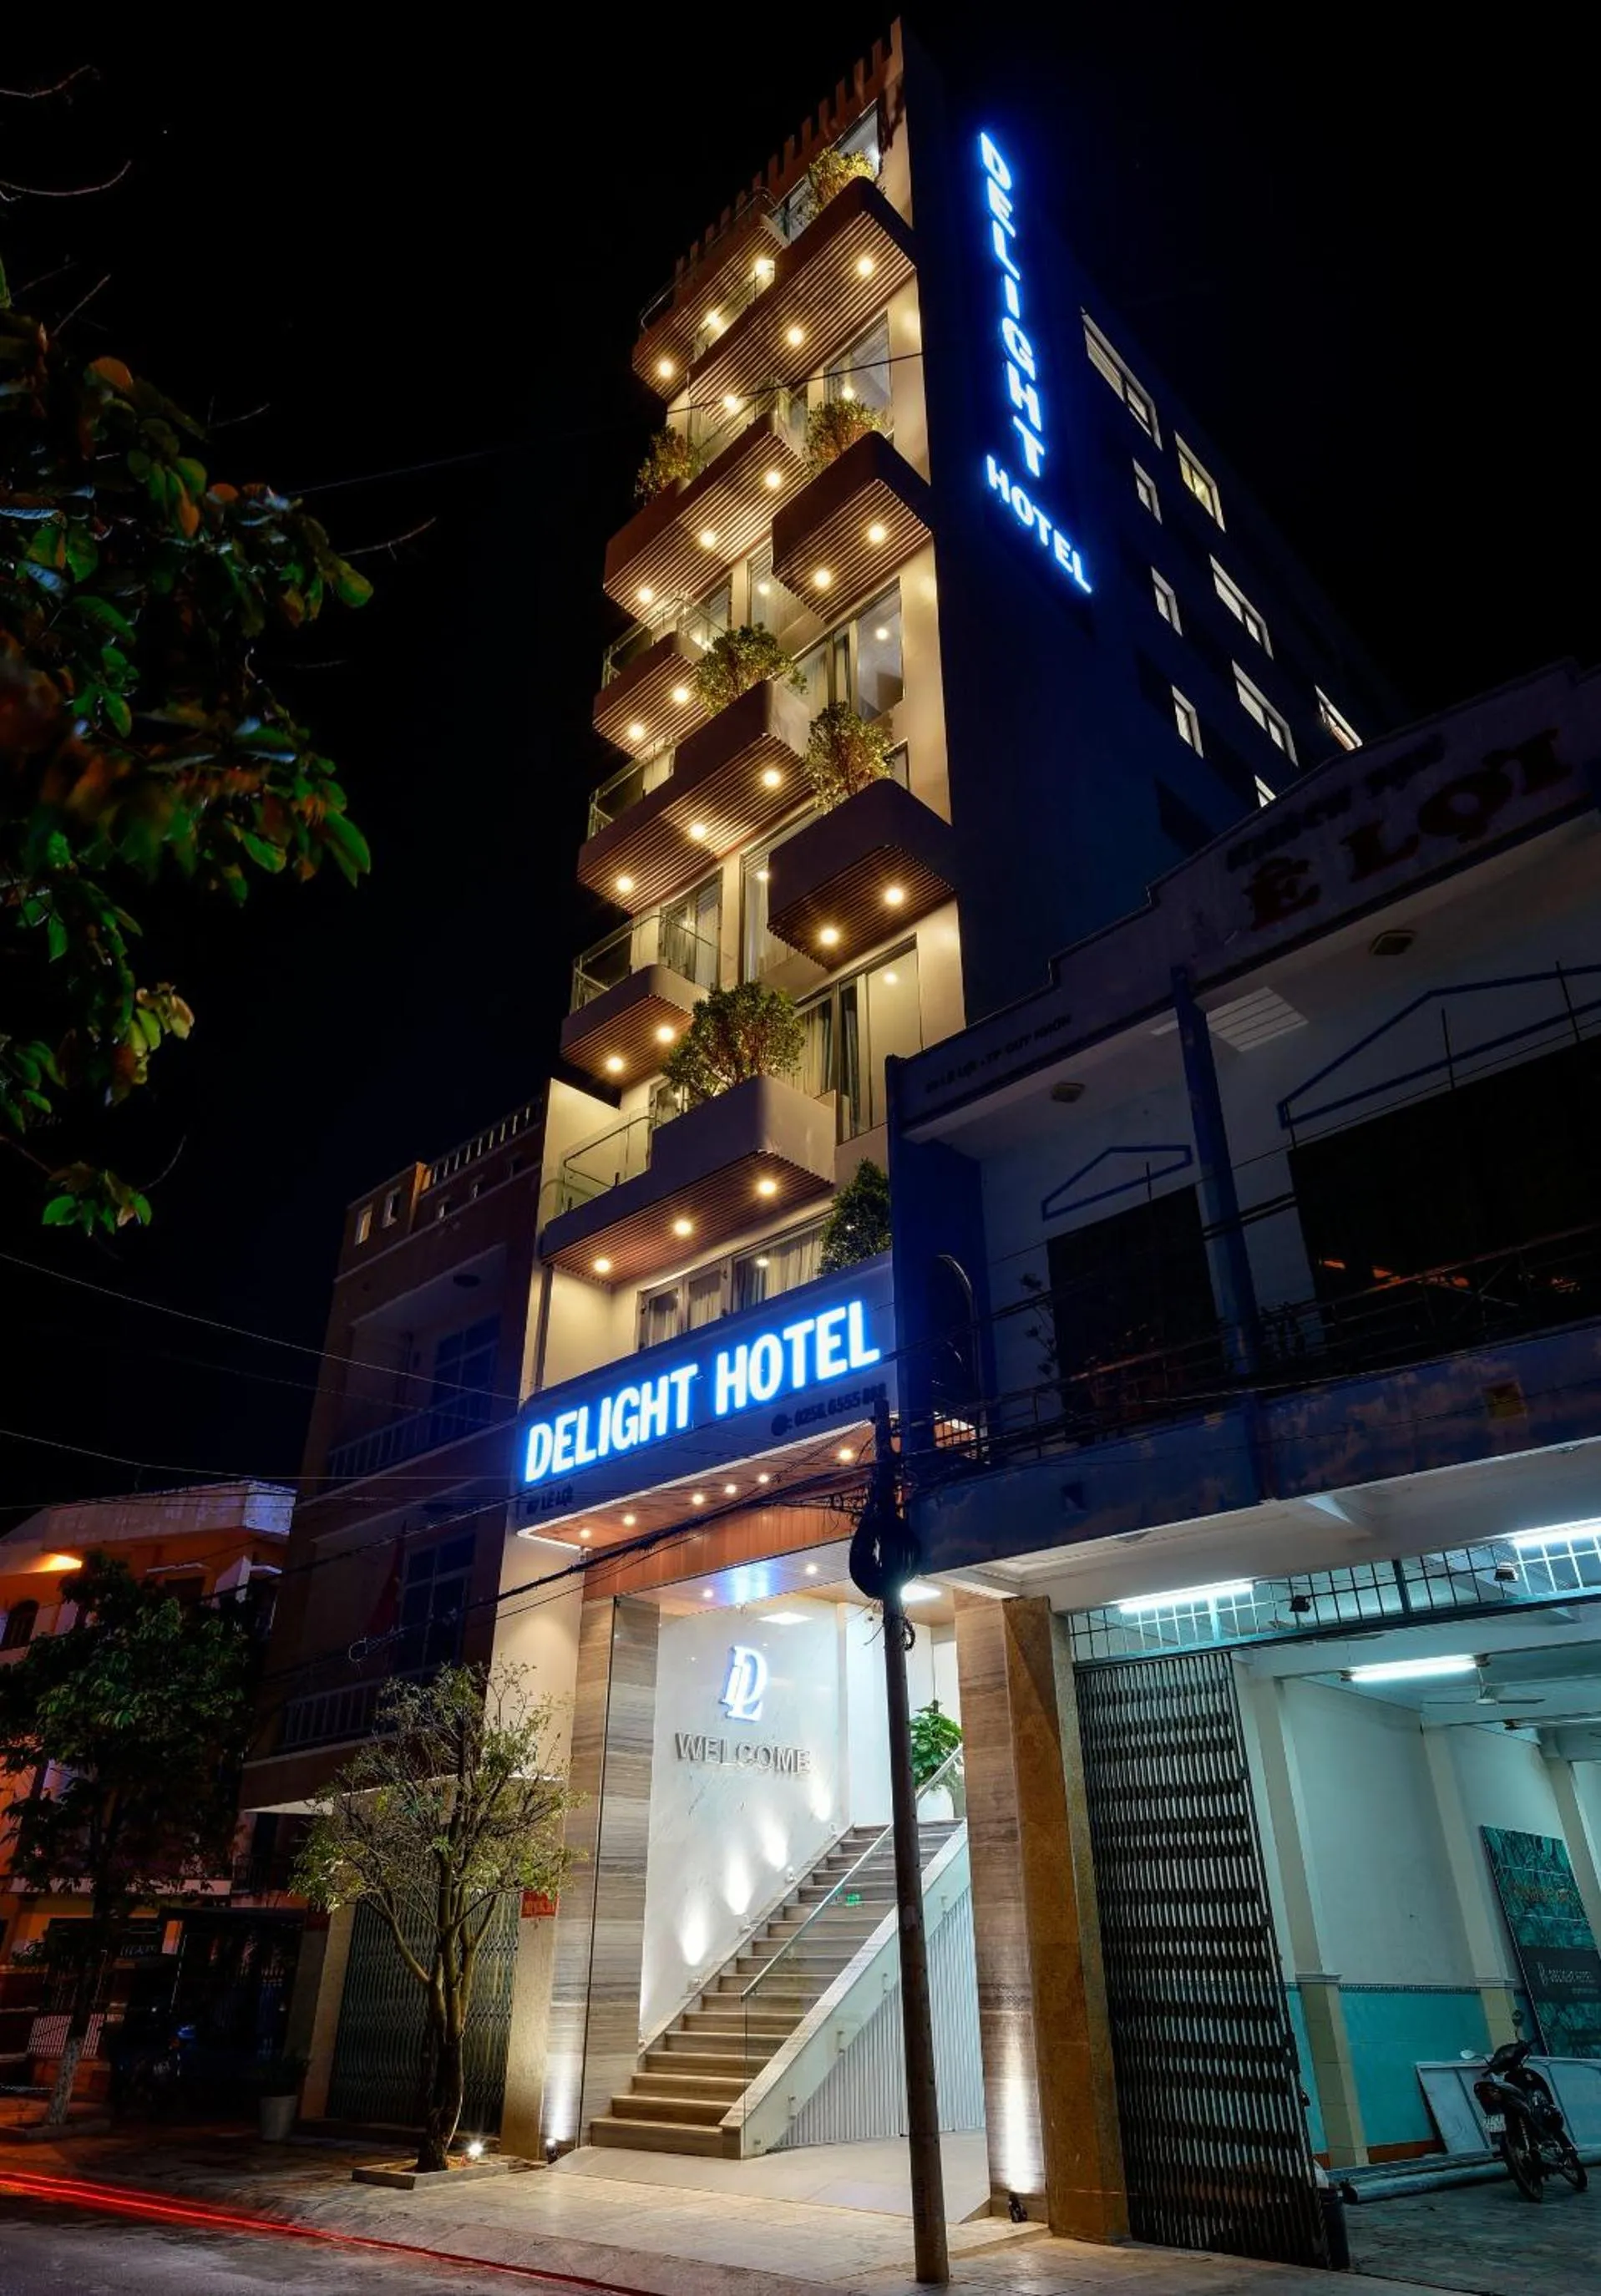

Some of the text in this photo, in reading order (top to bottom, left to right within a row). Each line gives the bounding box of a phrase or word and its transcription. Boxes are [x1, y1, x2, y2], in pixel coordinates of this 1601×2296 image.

[980, 131, 1045, 478] DELIGHT
[986, 454, 1092, 594] HOTEL
[524, 1300, 880, 1483] DELIGHT HOTEL
[674, 1731, 812, 1774] WELCOME
